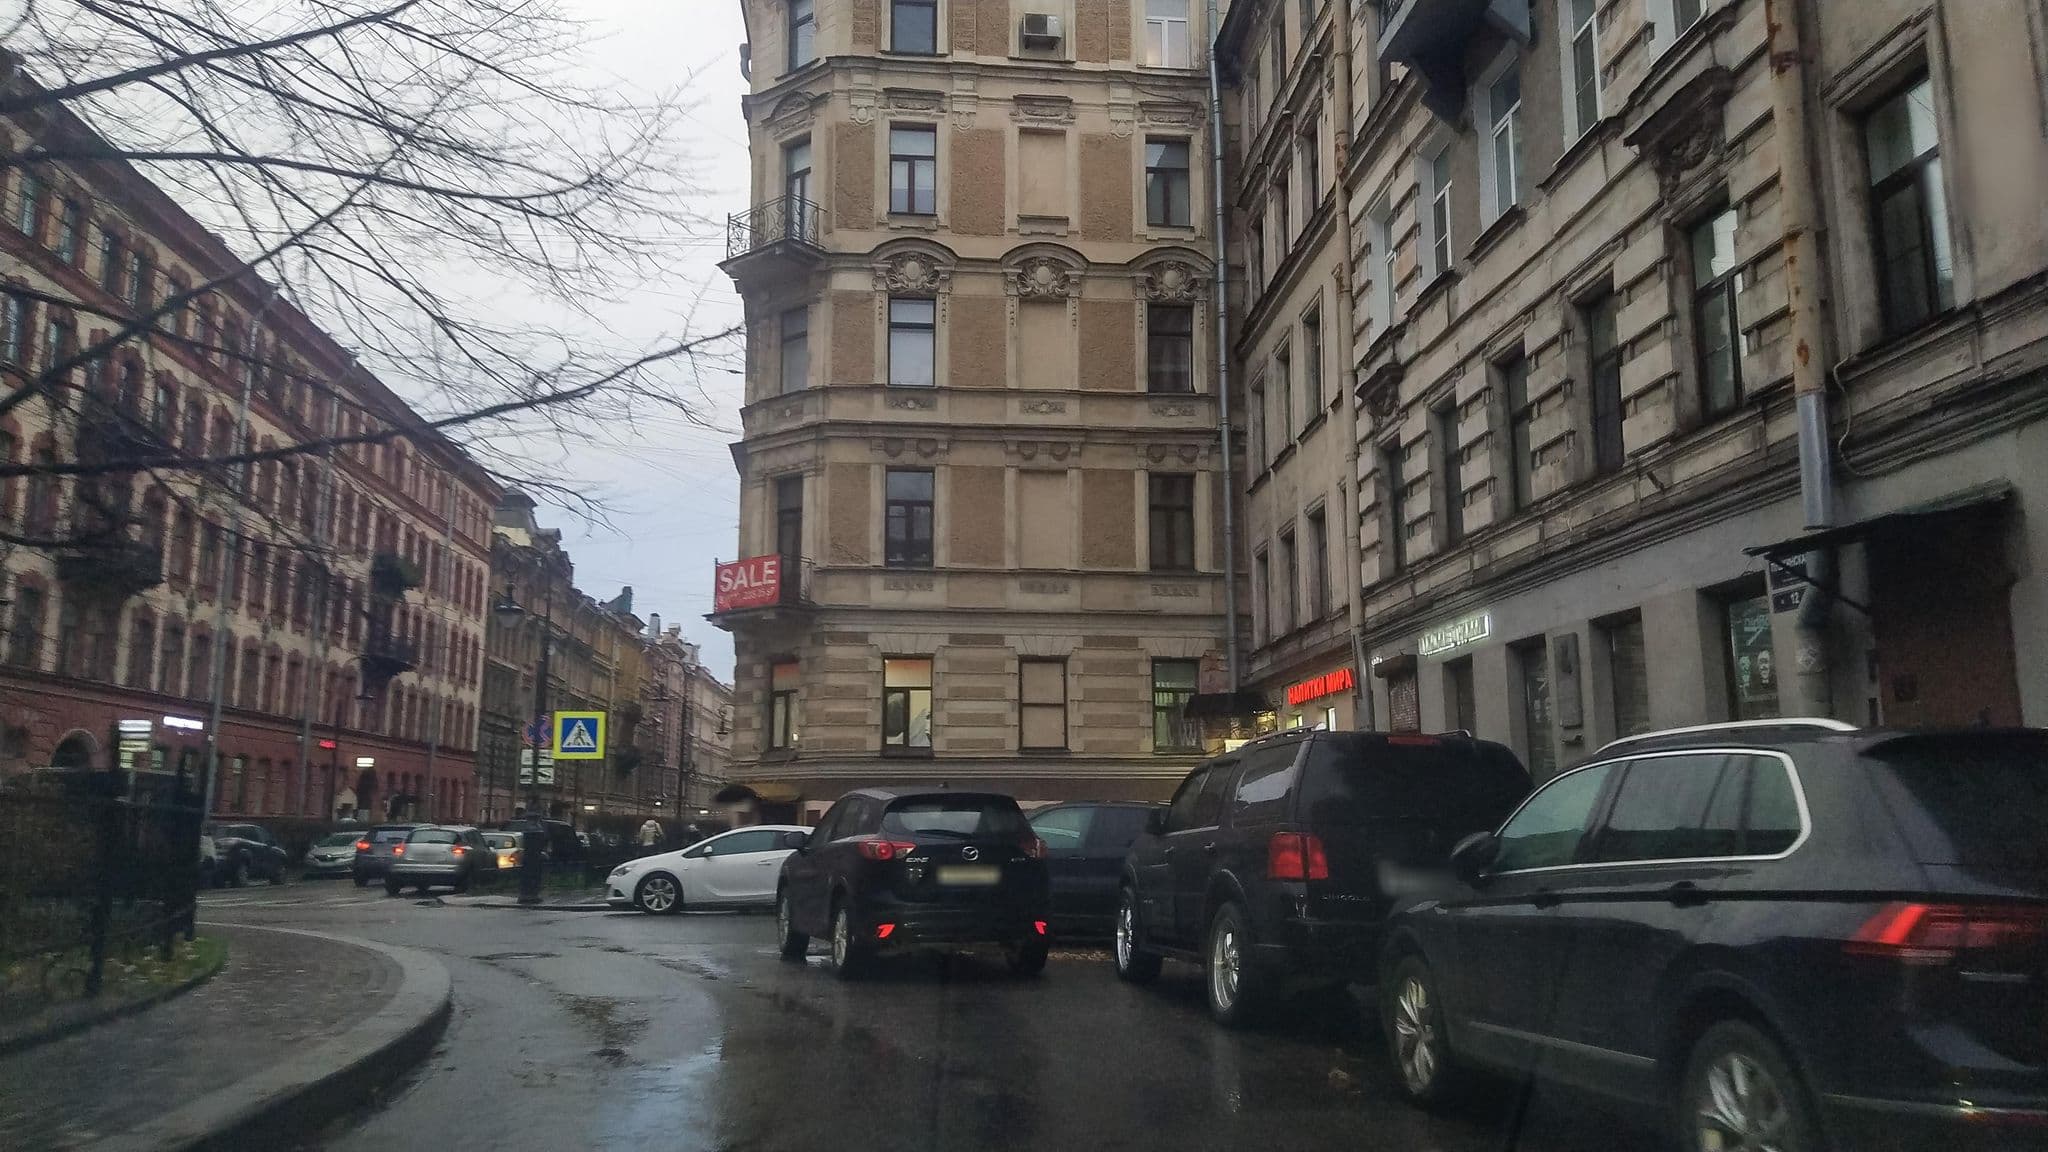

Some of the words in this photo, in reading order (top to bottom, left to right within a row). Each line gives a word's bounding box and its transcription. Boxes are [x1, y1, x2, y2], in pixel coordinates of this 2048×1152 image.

[720, 560, 777, 593] SALE
[1287, 676, 1326, 705] НАПИТКИ
[1326, 667, 1353, 693] МИРА
